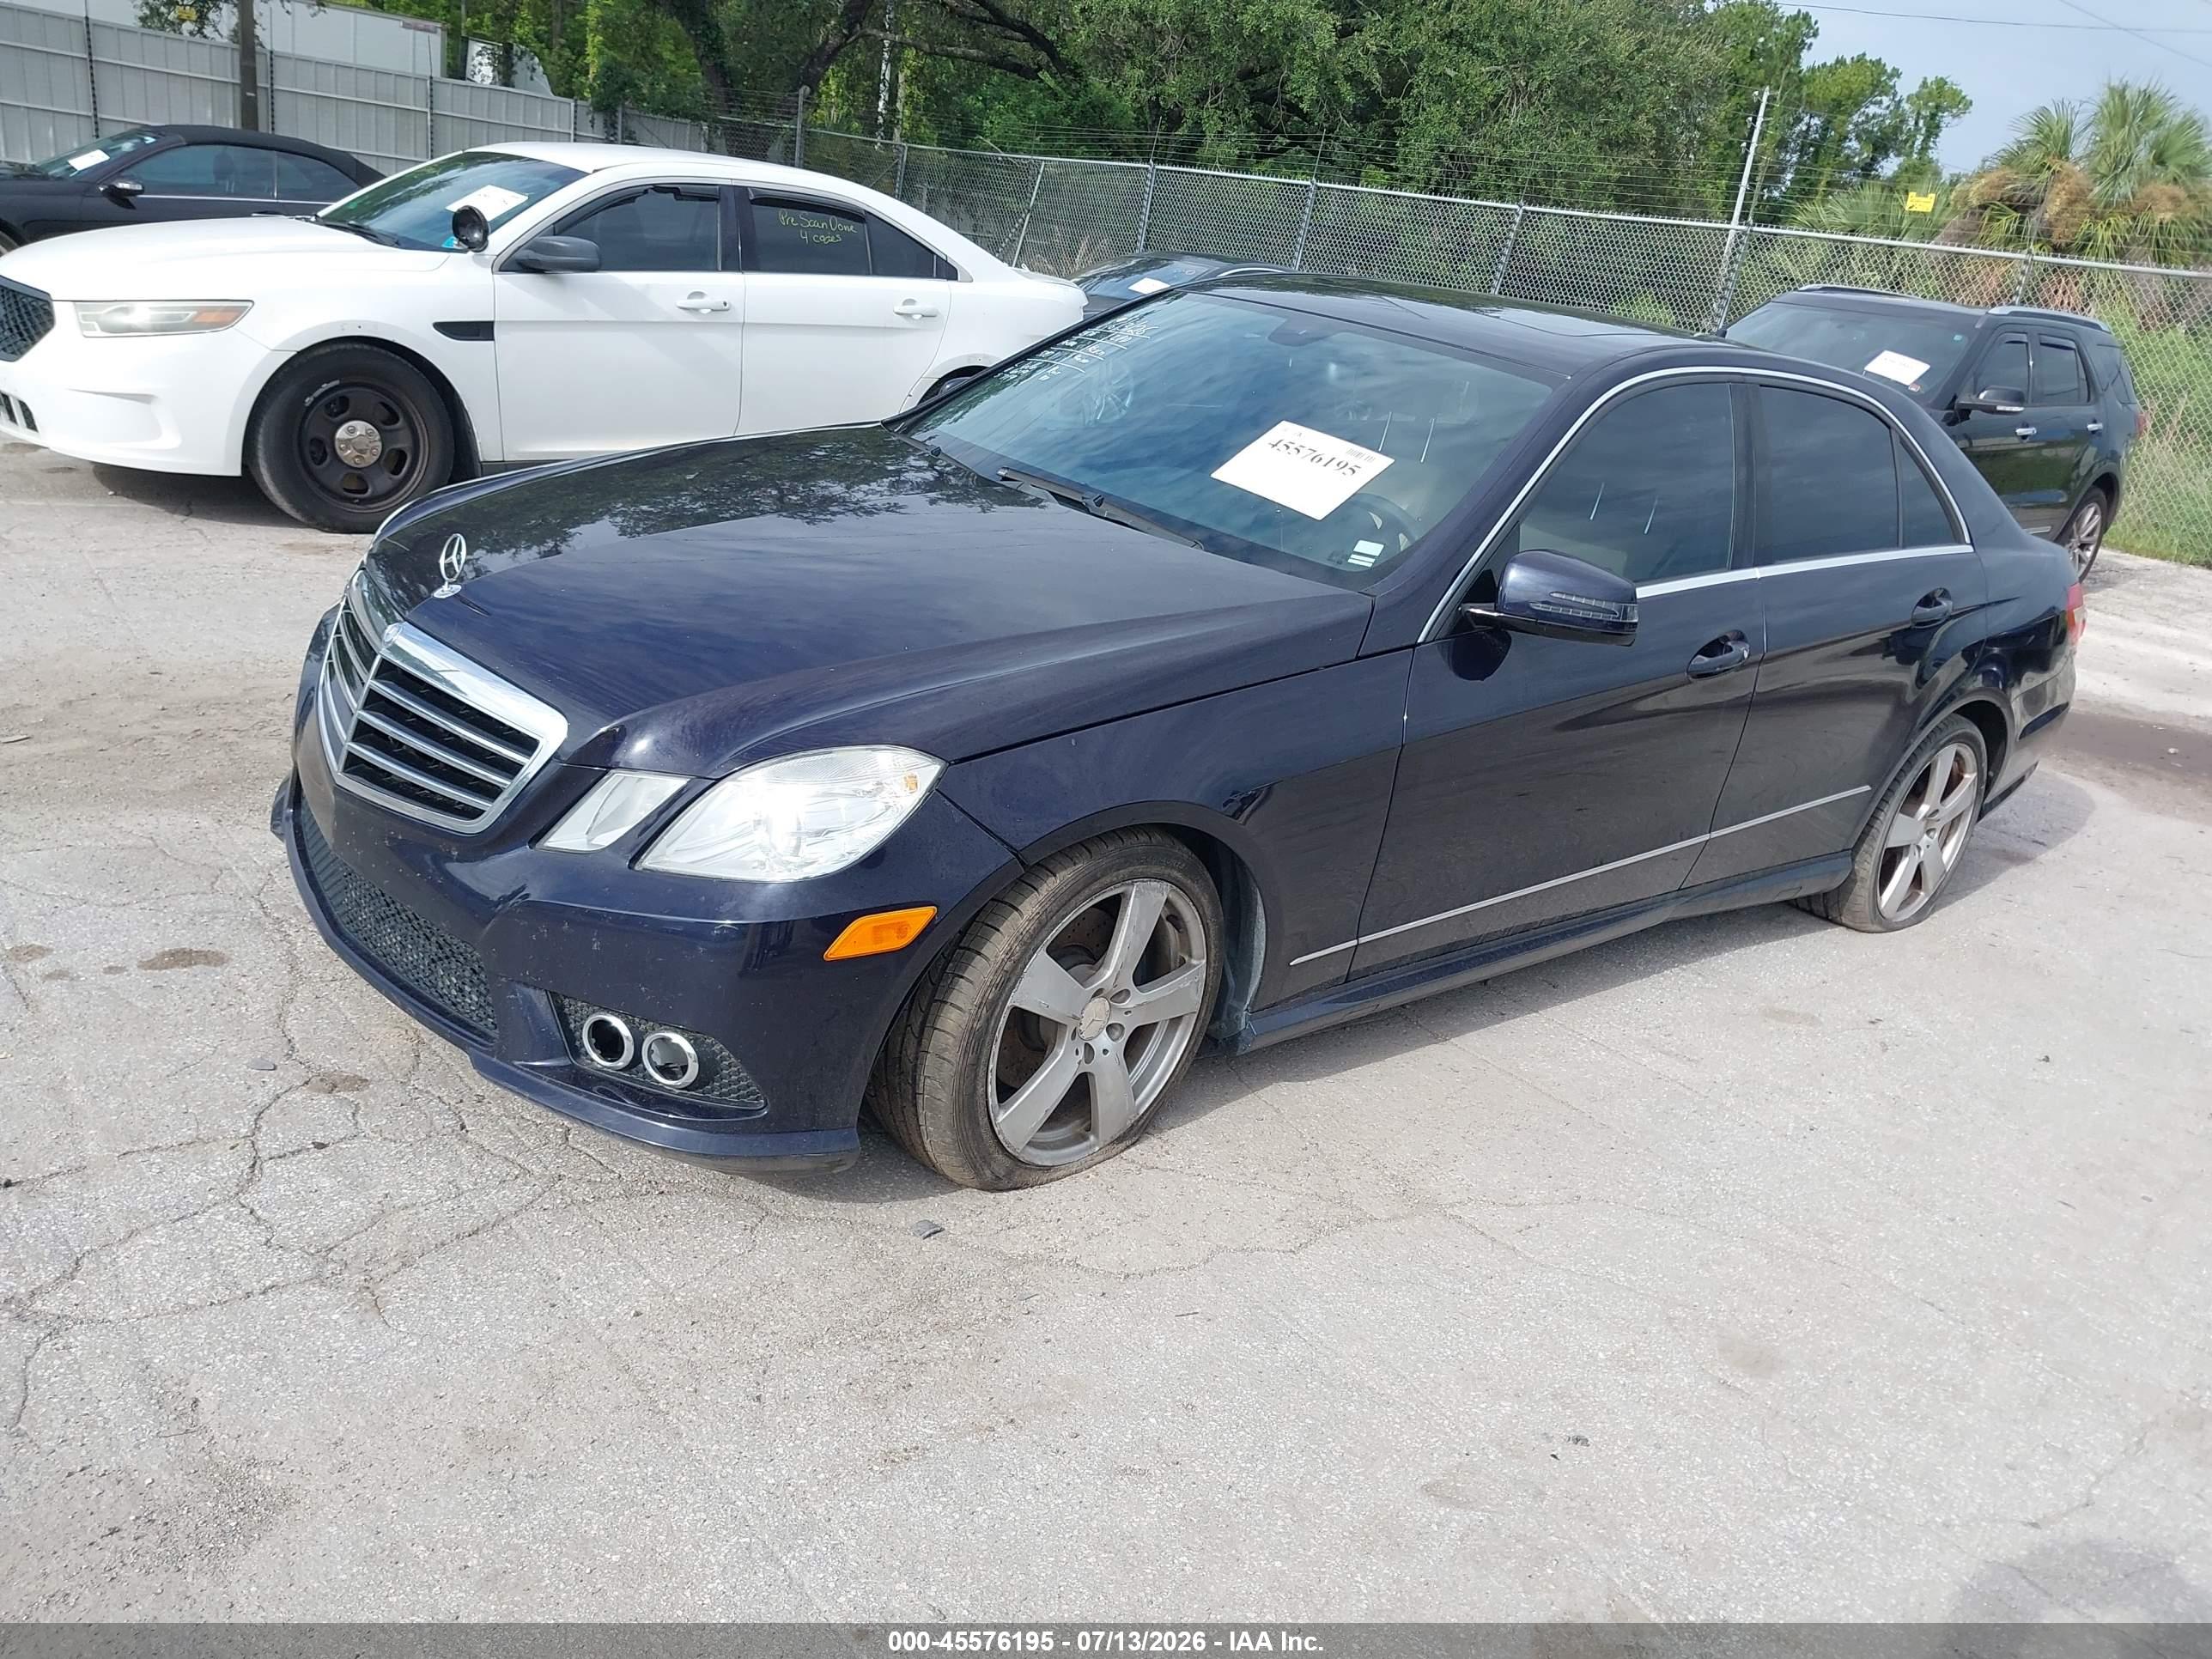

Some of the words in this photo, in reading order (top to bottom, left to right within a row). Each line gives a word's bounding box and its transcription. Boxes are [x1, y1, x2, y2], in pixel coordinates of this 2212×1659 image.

[778, 209, 799, 226] Pre
[799, 212, 828, 229] Scan
[829, 215, 858, 234] Done
[799, 229, 809, 246] 4
[1267, 438, 1363, 477] 45576195
